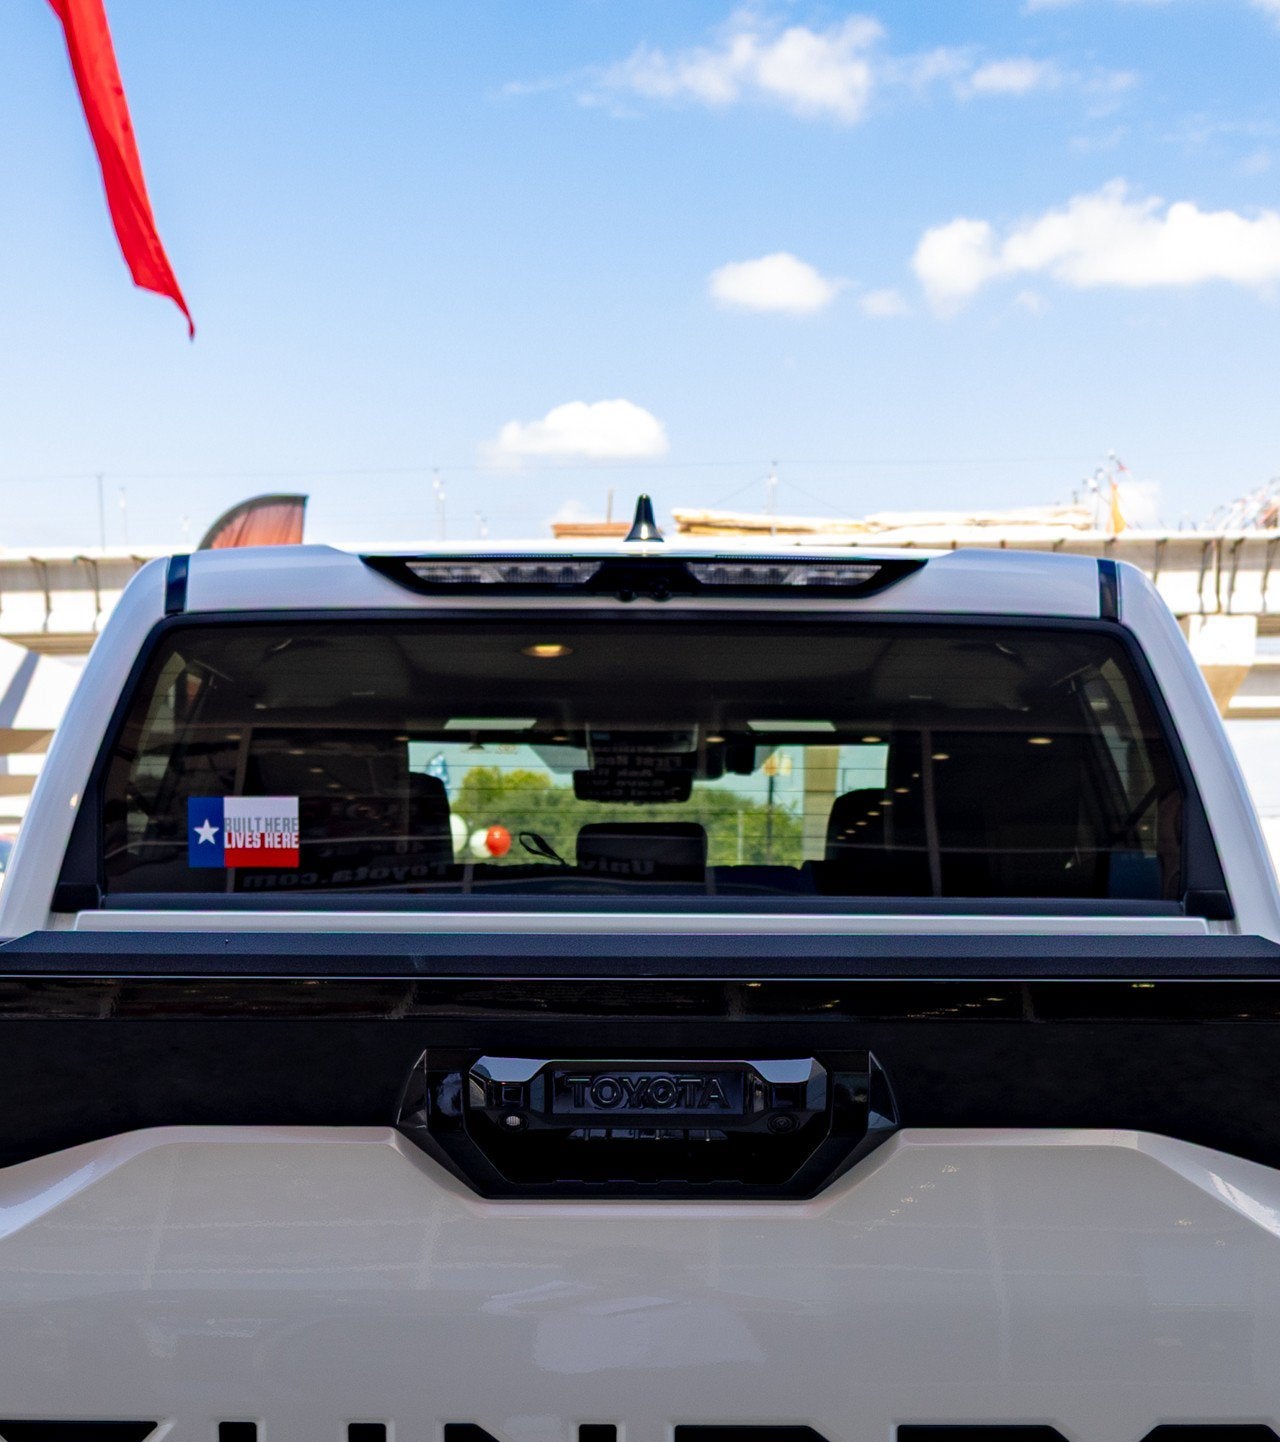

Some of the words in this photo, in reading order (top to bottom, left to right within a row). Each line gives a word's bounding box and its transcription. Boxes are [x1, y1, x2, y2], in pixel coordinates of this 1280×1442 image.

[224, 816, 261, 833] BUILT
[265, 816, 299, 833] HERE
[224, 832, 261, 849] LIVES
[265, 832, 299, 849] HERE
[565, 1075, 732, 1110] TOYOTA
